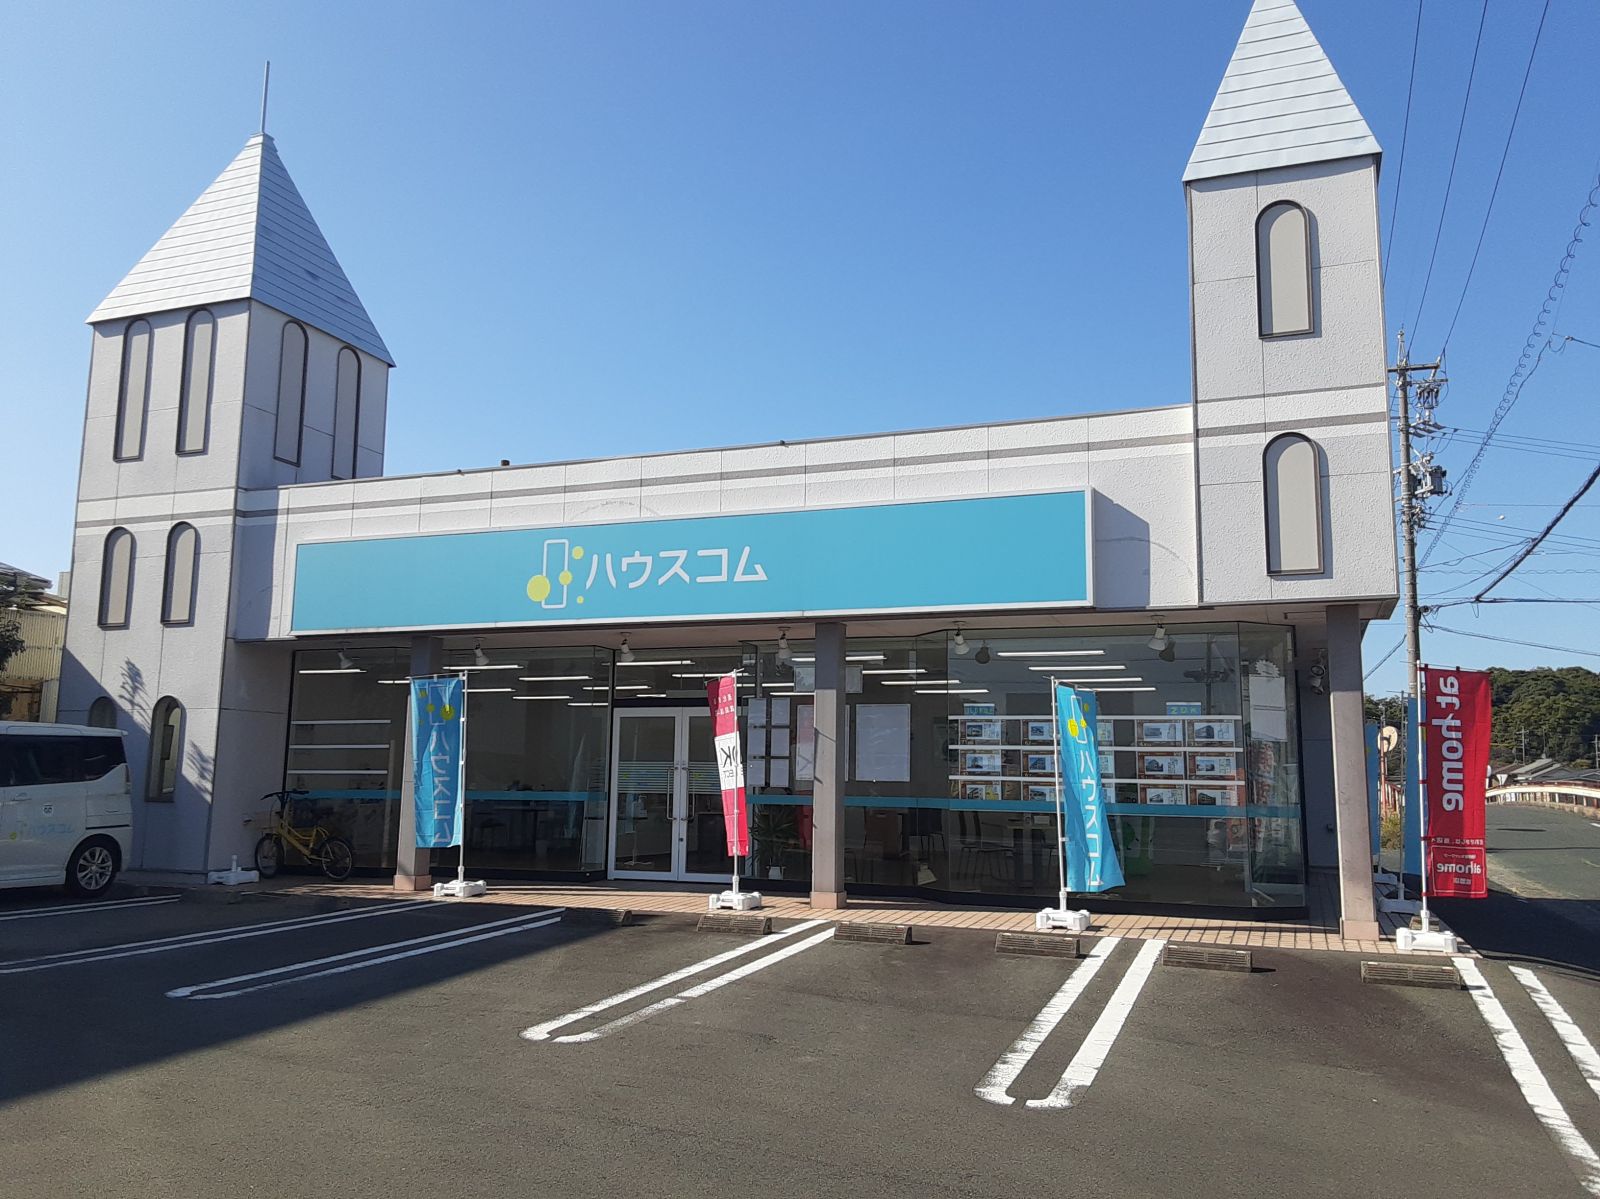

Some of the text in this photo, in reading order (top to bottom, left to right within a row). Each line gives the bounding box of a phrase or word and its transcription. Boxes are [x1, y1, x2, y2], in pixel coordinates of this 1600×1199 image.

[586, 545, 768, 590] ハウスコム
[1079, 749, 1104, 887] ハウスコム
